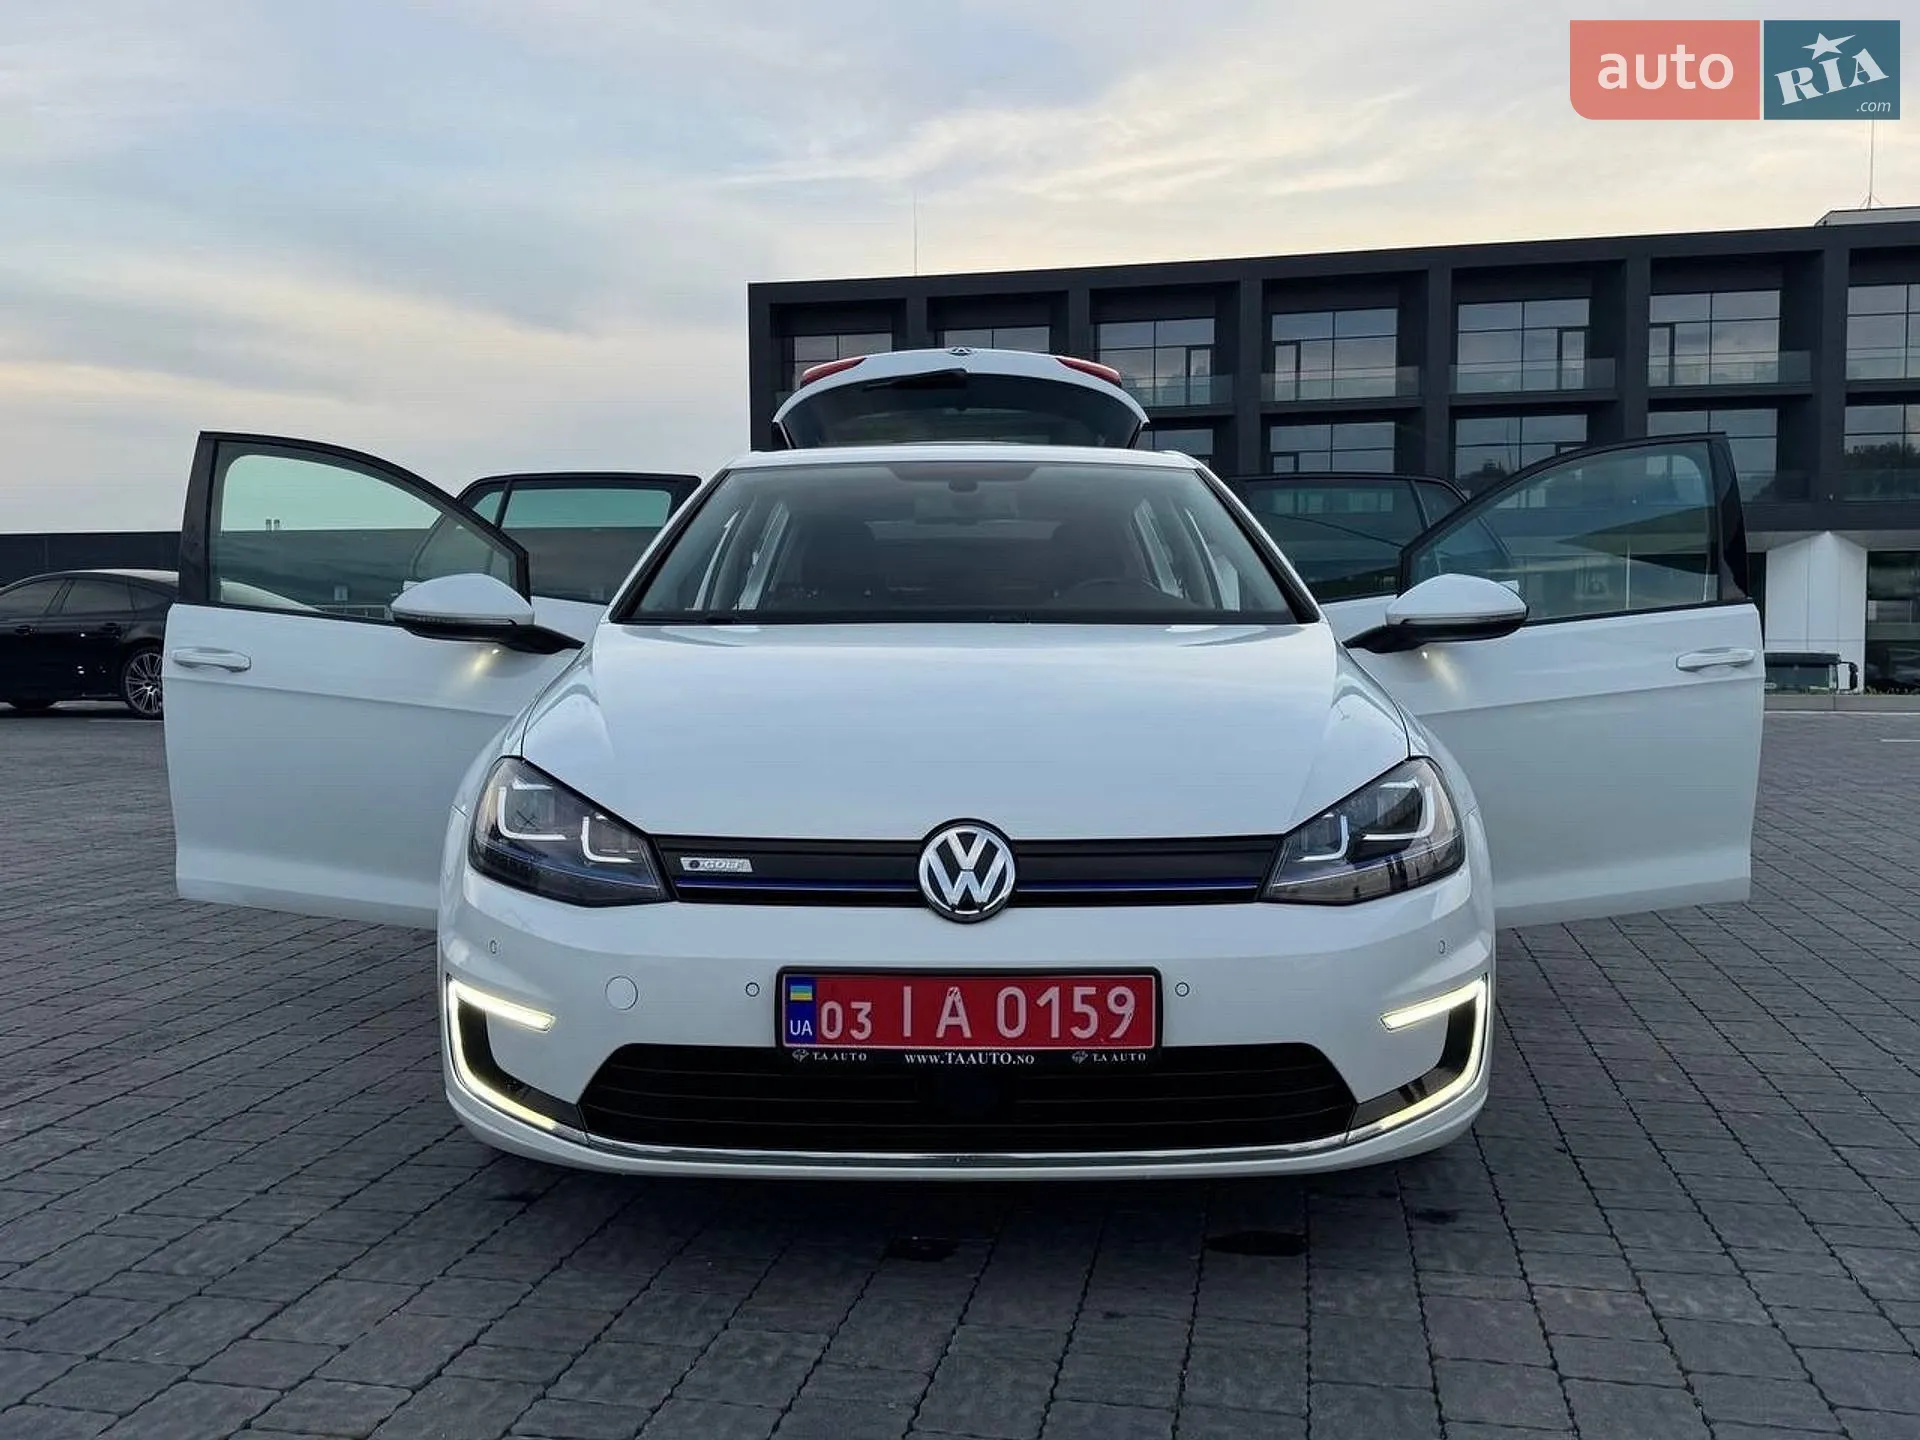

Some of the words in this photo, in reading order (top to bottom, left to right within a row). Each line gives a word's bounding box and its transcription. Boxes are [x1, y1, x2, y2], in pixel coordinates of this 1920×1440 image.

[790, 1018, 813, 1037] UA
[820, 1000, 872, 1040] 03
[995, 986, 1136, 1040] 0159
